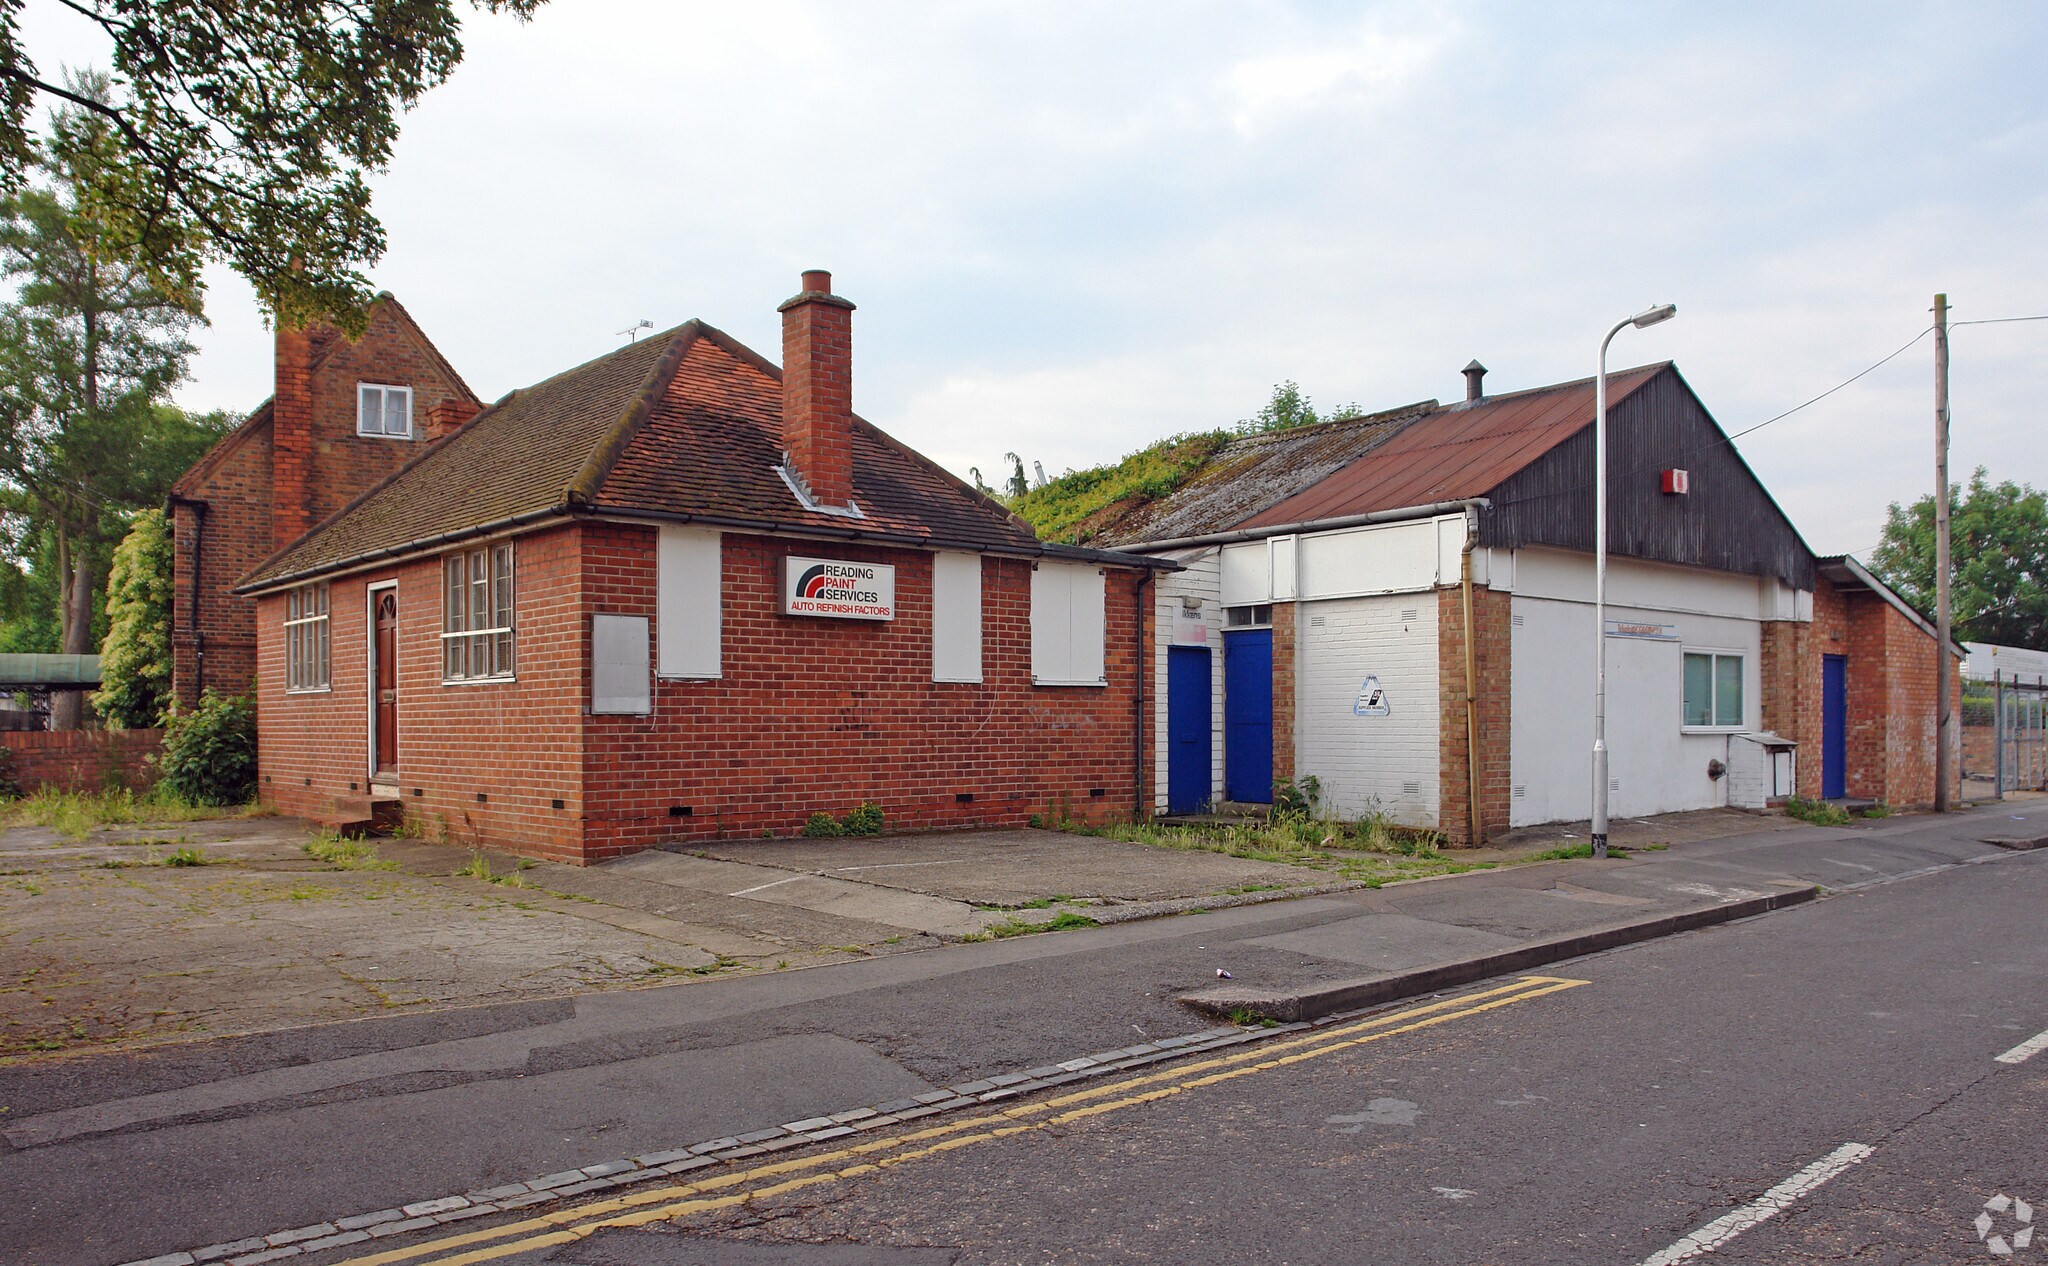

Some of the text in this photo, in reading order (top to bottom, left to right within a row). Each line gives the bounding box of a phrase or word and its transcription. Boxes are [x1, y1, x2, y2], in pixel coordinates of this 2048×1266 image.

[825, 565, 874, 579] READING
[825, 577, 856, 589] PAINT
[825, 589, 878, 603] SERVICES
[791, 601, 890, 616] AUTO REFINISH FACTORS
